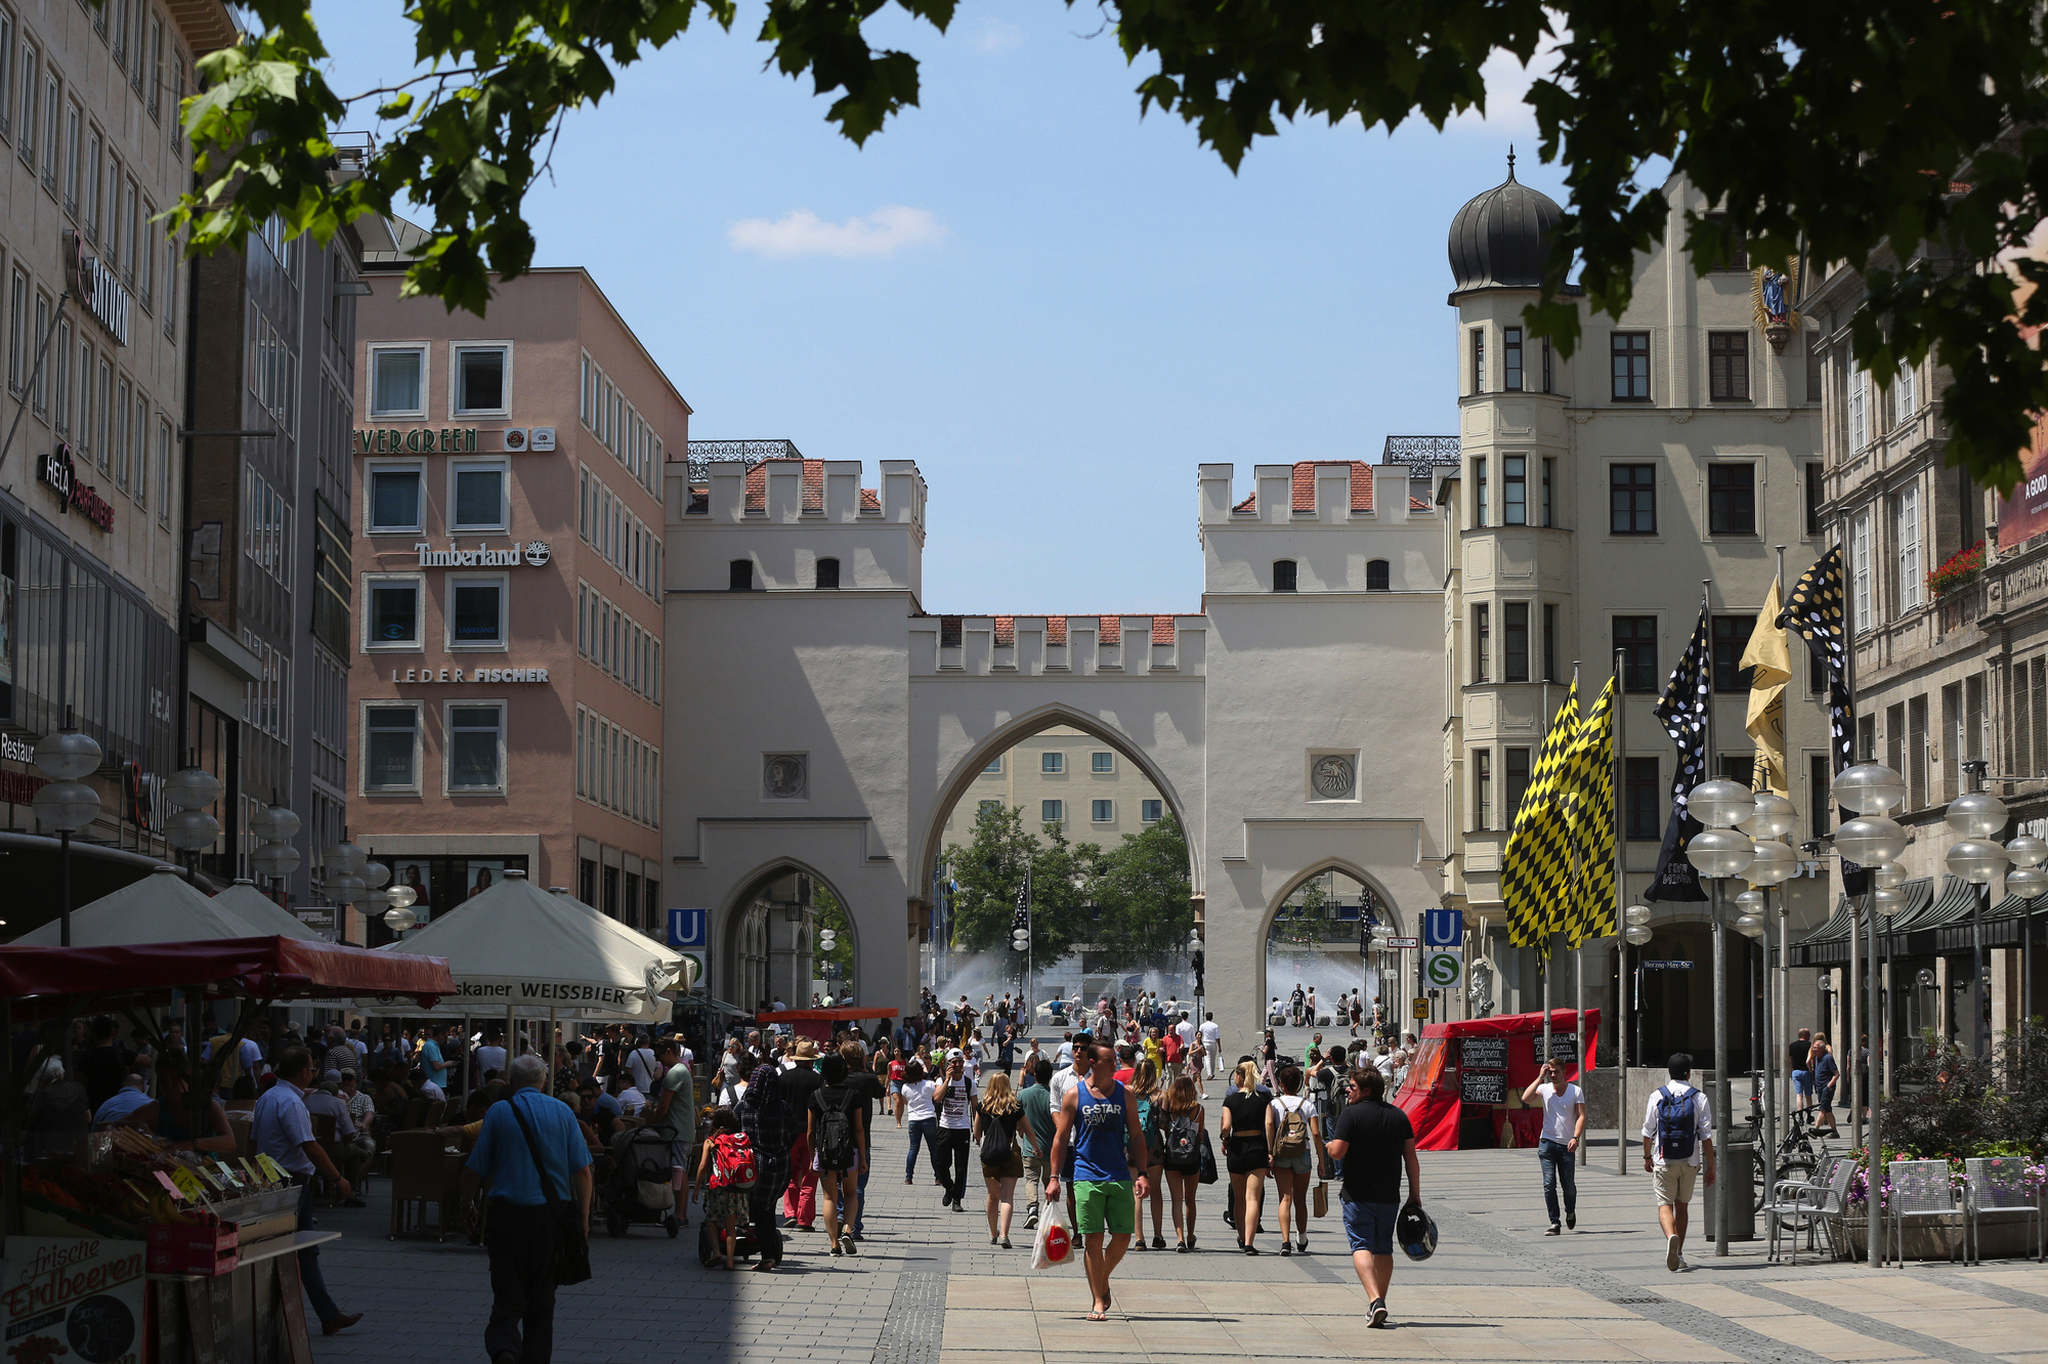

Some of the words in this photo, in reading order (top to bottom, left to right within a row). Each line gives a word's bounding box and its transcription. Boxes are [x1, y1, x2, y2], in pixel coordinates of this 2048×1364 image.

[91, 256, 128, 347] SATURN
[2025, 483, 2031, 500] A
[2030, 474, 2047, 497] GOOD
[415, 543, 522, 567] Timberland
[392, 669, 464, 683] LEDER
[474, 668, 549, 683] FISCHER
[1, 732, 37, 765] Restaur
[675, 911, 698, 943] U
[1432, 912, 1455, 944] U
[1433, 957, 1454, 982] S
[454, 982, 513, 997] skaner
[520, 982, 626, 1005] WEISSBIER
[1082, 1103, 1122, 1115] G-STAR
[1084, 1114, 1107, 1126] RAW
[20, 1239, 100, 1285] frische
[2, 1253, 143, 1317] Erdbeeren
